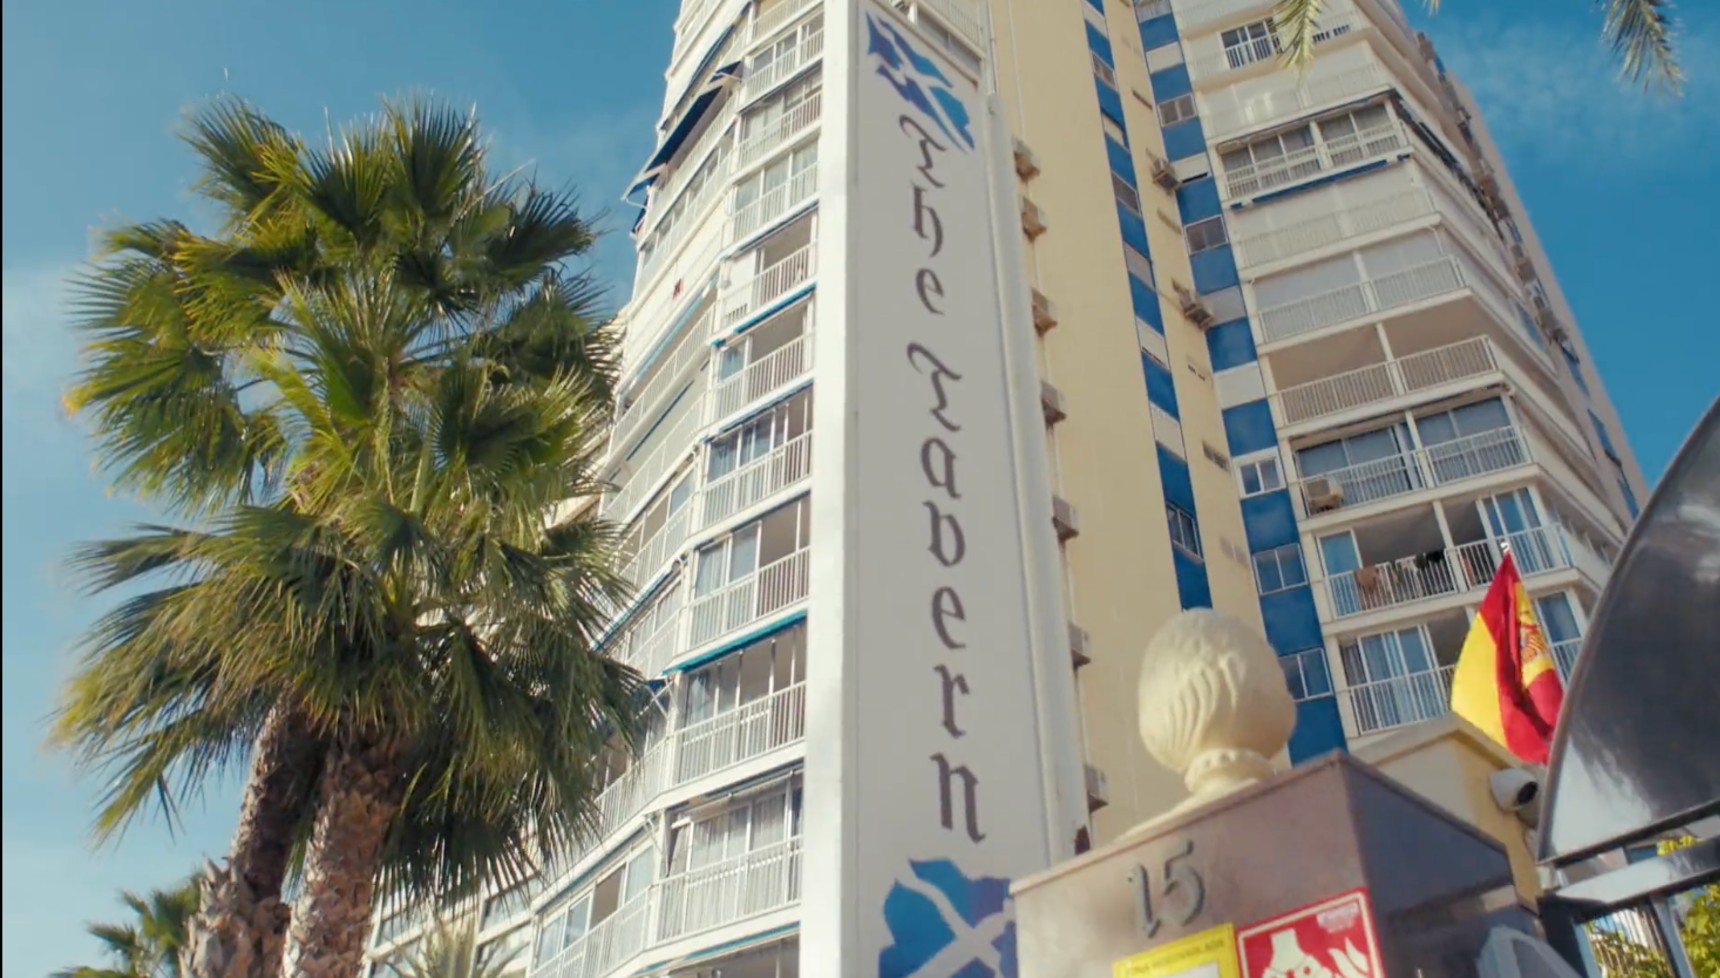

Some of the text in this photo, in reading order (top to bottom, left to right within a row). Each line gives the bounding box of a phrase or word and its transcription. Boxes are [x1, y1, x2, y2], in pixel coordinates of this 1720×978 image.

[899, 114, 986, 843] The Tavern
[1127, 839, 1205, 939] 15
